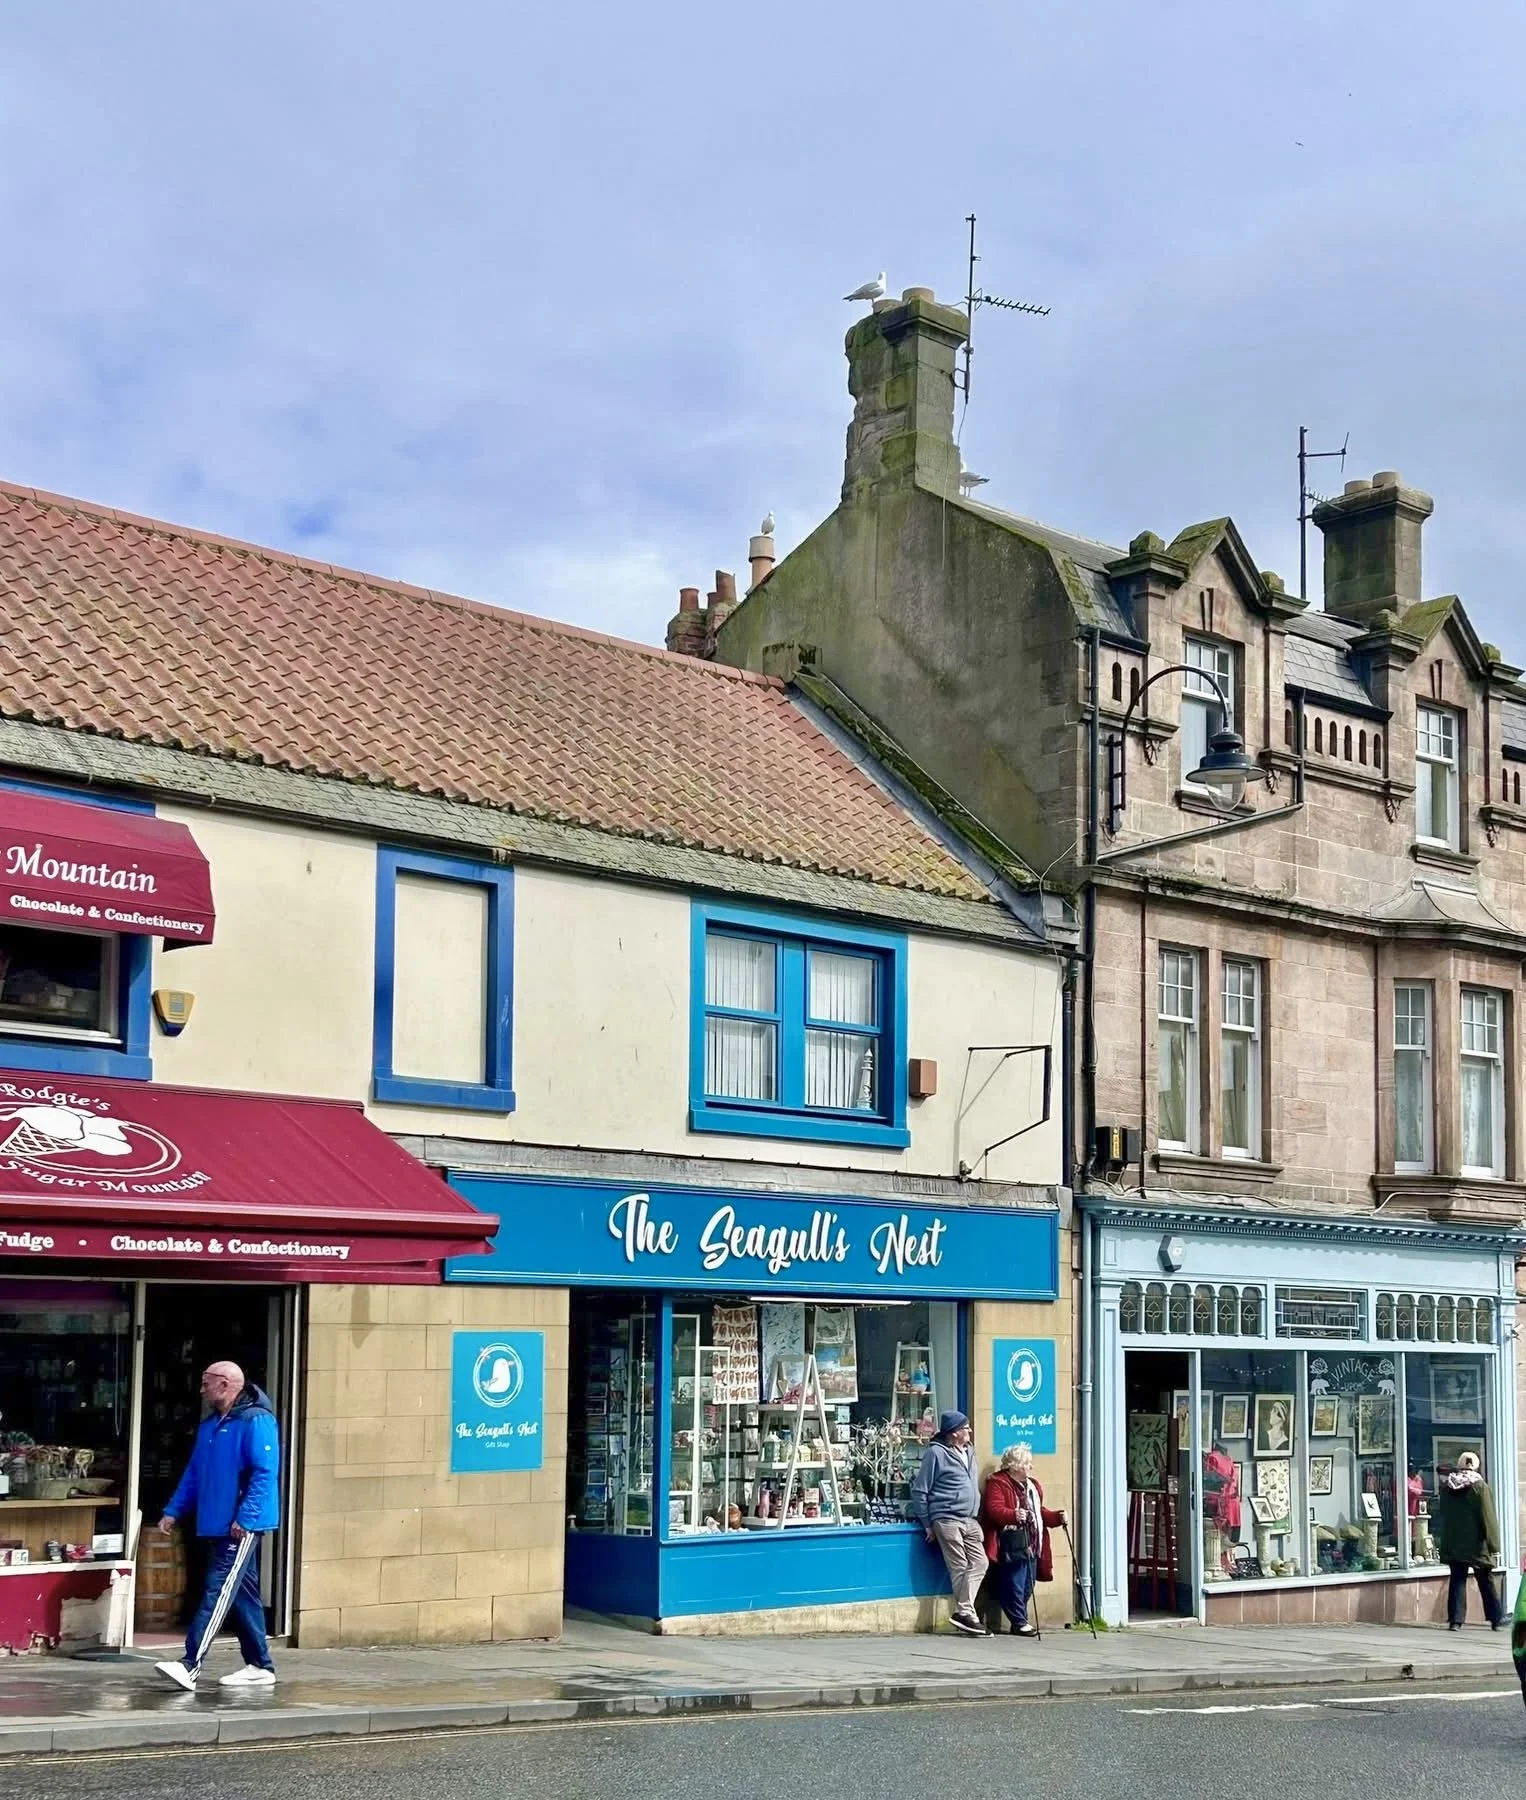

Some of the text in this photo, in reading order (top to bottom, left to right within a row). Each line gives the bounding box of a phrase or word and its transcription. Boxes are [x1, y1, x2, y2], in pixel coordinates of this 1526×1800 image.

[6, 844, 157, 894] Mountain
[10, 894, 205, 935] Chocolate & Confectionery
[0, 1083, 111, 1111] Rodgie's
[0, 1160, 212, 1194] Sugar Mountain
[110, 1235, 350, 1260] Chocolate & Confectionery
[608, 1193, 947, 1275] The Seagull's Nest
[1331, 1358, 1374, 1382] VINTAGE
